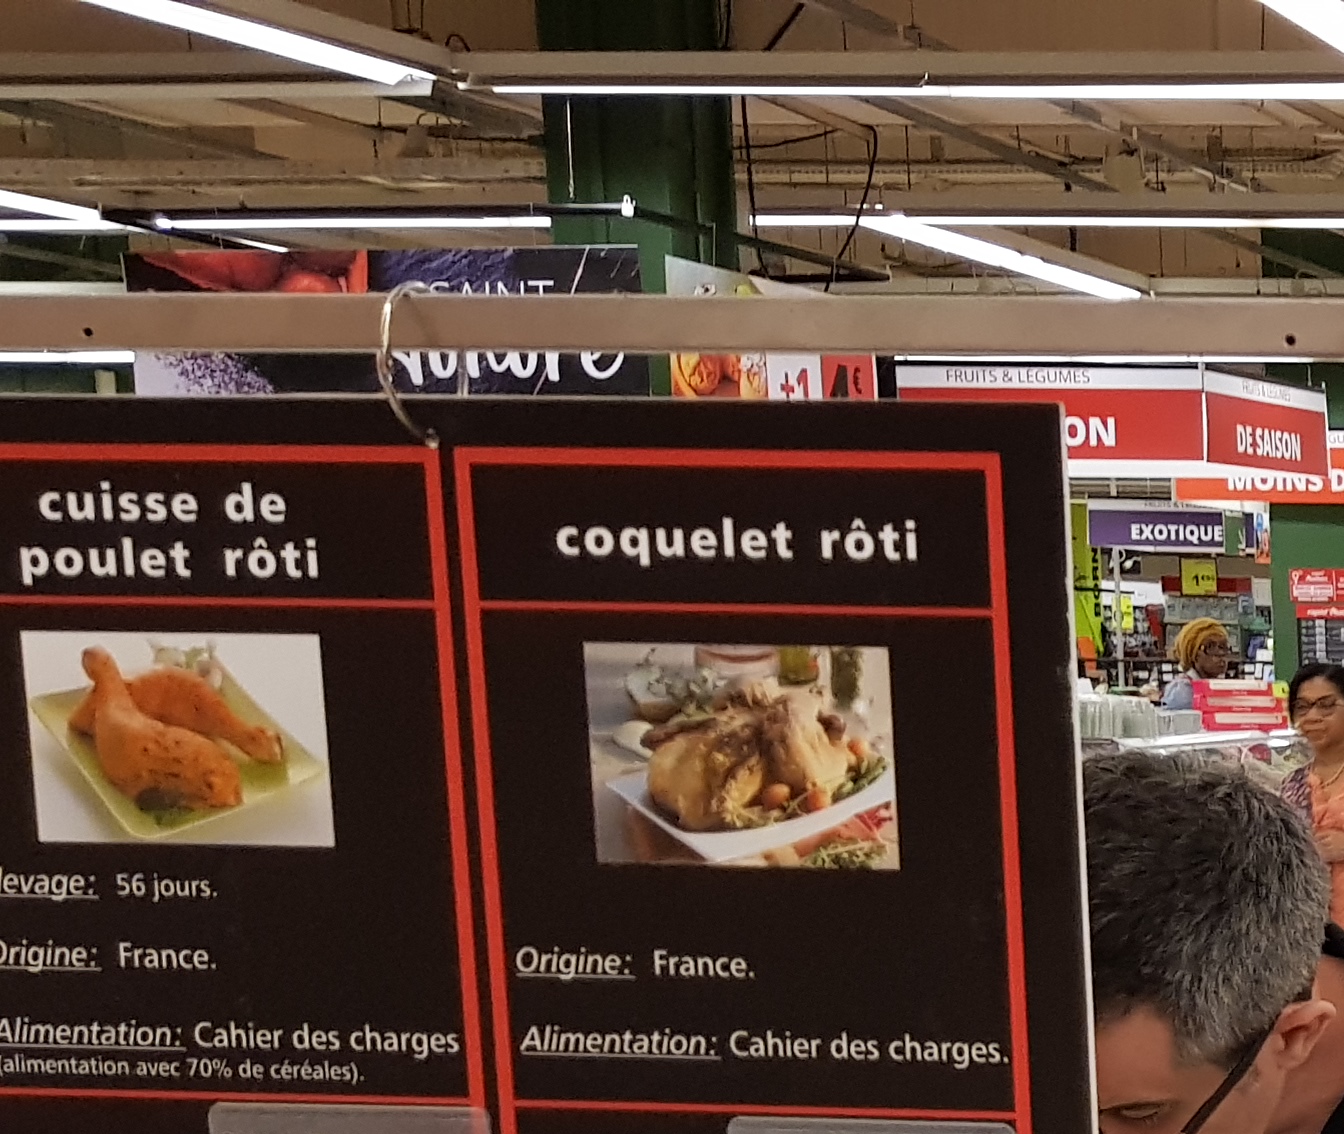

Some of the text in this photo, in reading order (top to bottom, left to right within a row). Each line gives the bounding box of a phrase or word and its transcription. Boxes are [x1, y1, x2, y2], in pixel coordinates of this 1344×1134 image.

[945, 368, 998, 383] FRUITS
[1002, 369, 1013, 383] &
[1236, 423, 1301, 461] DE SAISON
[38, 482, 288, 523] cuisse de
[555, 516, 919, 567] coquelet rôti
[1130, 523, 1224, 543] EXOTIQUE
[19, 537, 319, 585] poulet rôti
[1091, 548, 1101, 617] BORN
[115, 873, 146, 896] 56
[152, 872, 218, 902] jours.
[118, 942, 217, 970] France.
[516, 946, 755, 980] Origine: France.
[0, 1018, 459, 1057] Alimentation: Cahier des charges
[520, 1026, 1009, 1068] Alimentation: Cahier des charges.
[135, 1061, 180, 1078] avec
[186, 1059, 232, 1079] 70%
[238, 1060, 264, 1080] de
[270, 1060, 364, 1084] céréales).
